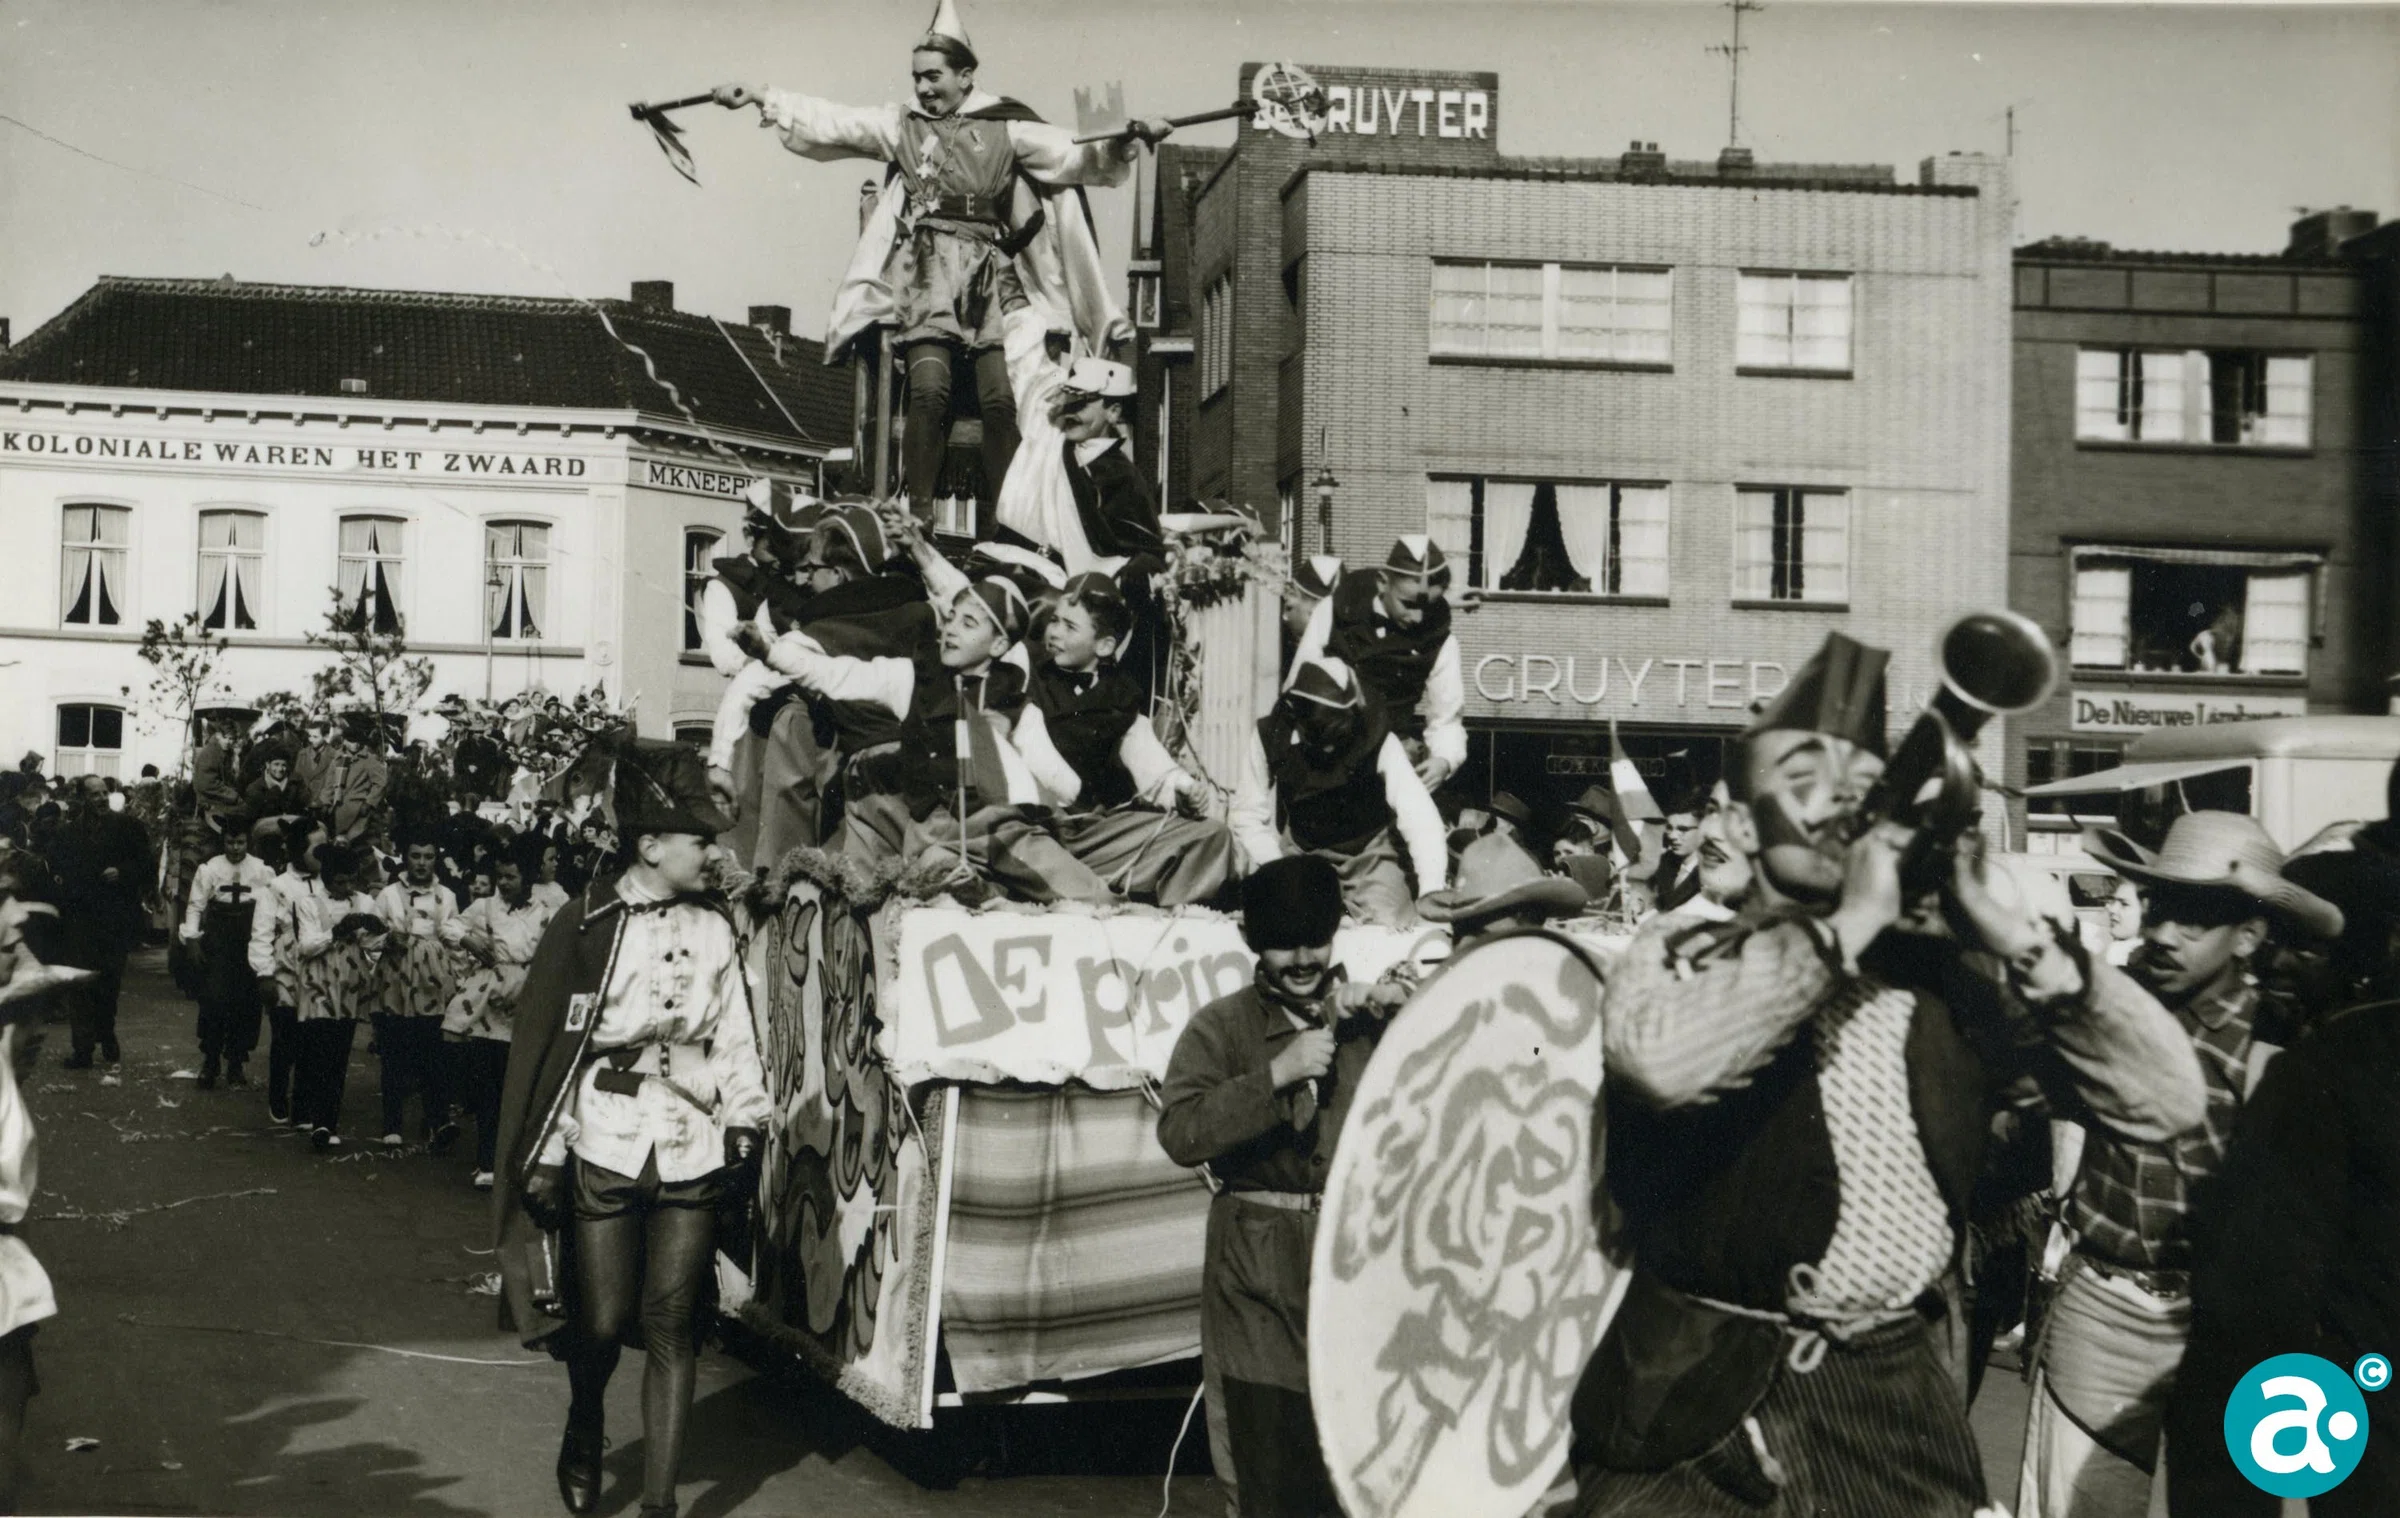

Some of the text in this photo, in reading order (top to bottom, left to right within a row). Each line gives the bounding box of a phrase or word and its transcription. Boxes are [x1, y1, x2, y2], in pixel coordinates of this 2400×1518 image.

[3, 432, 587, 477] KOLONIALE WAREN HET ZWAARD
[2076, 698, 2110, 725] De
[2112, 700, 2195, 727] Nieuwe
[922, 932, 1254, 1068] DE prin
